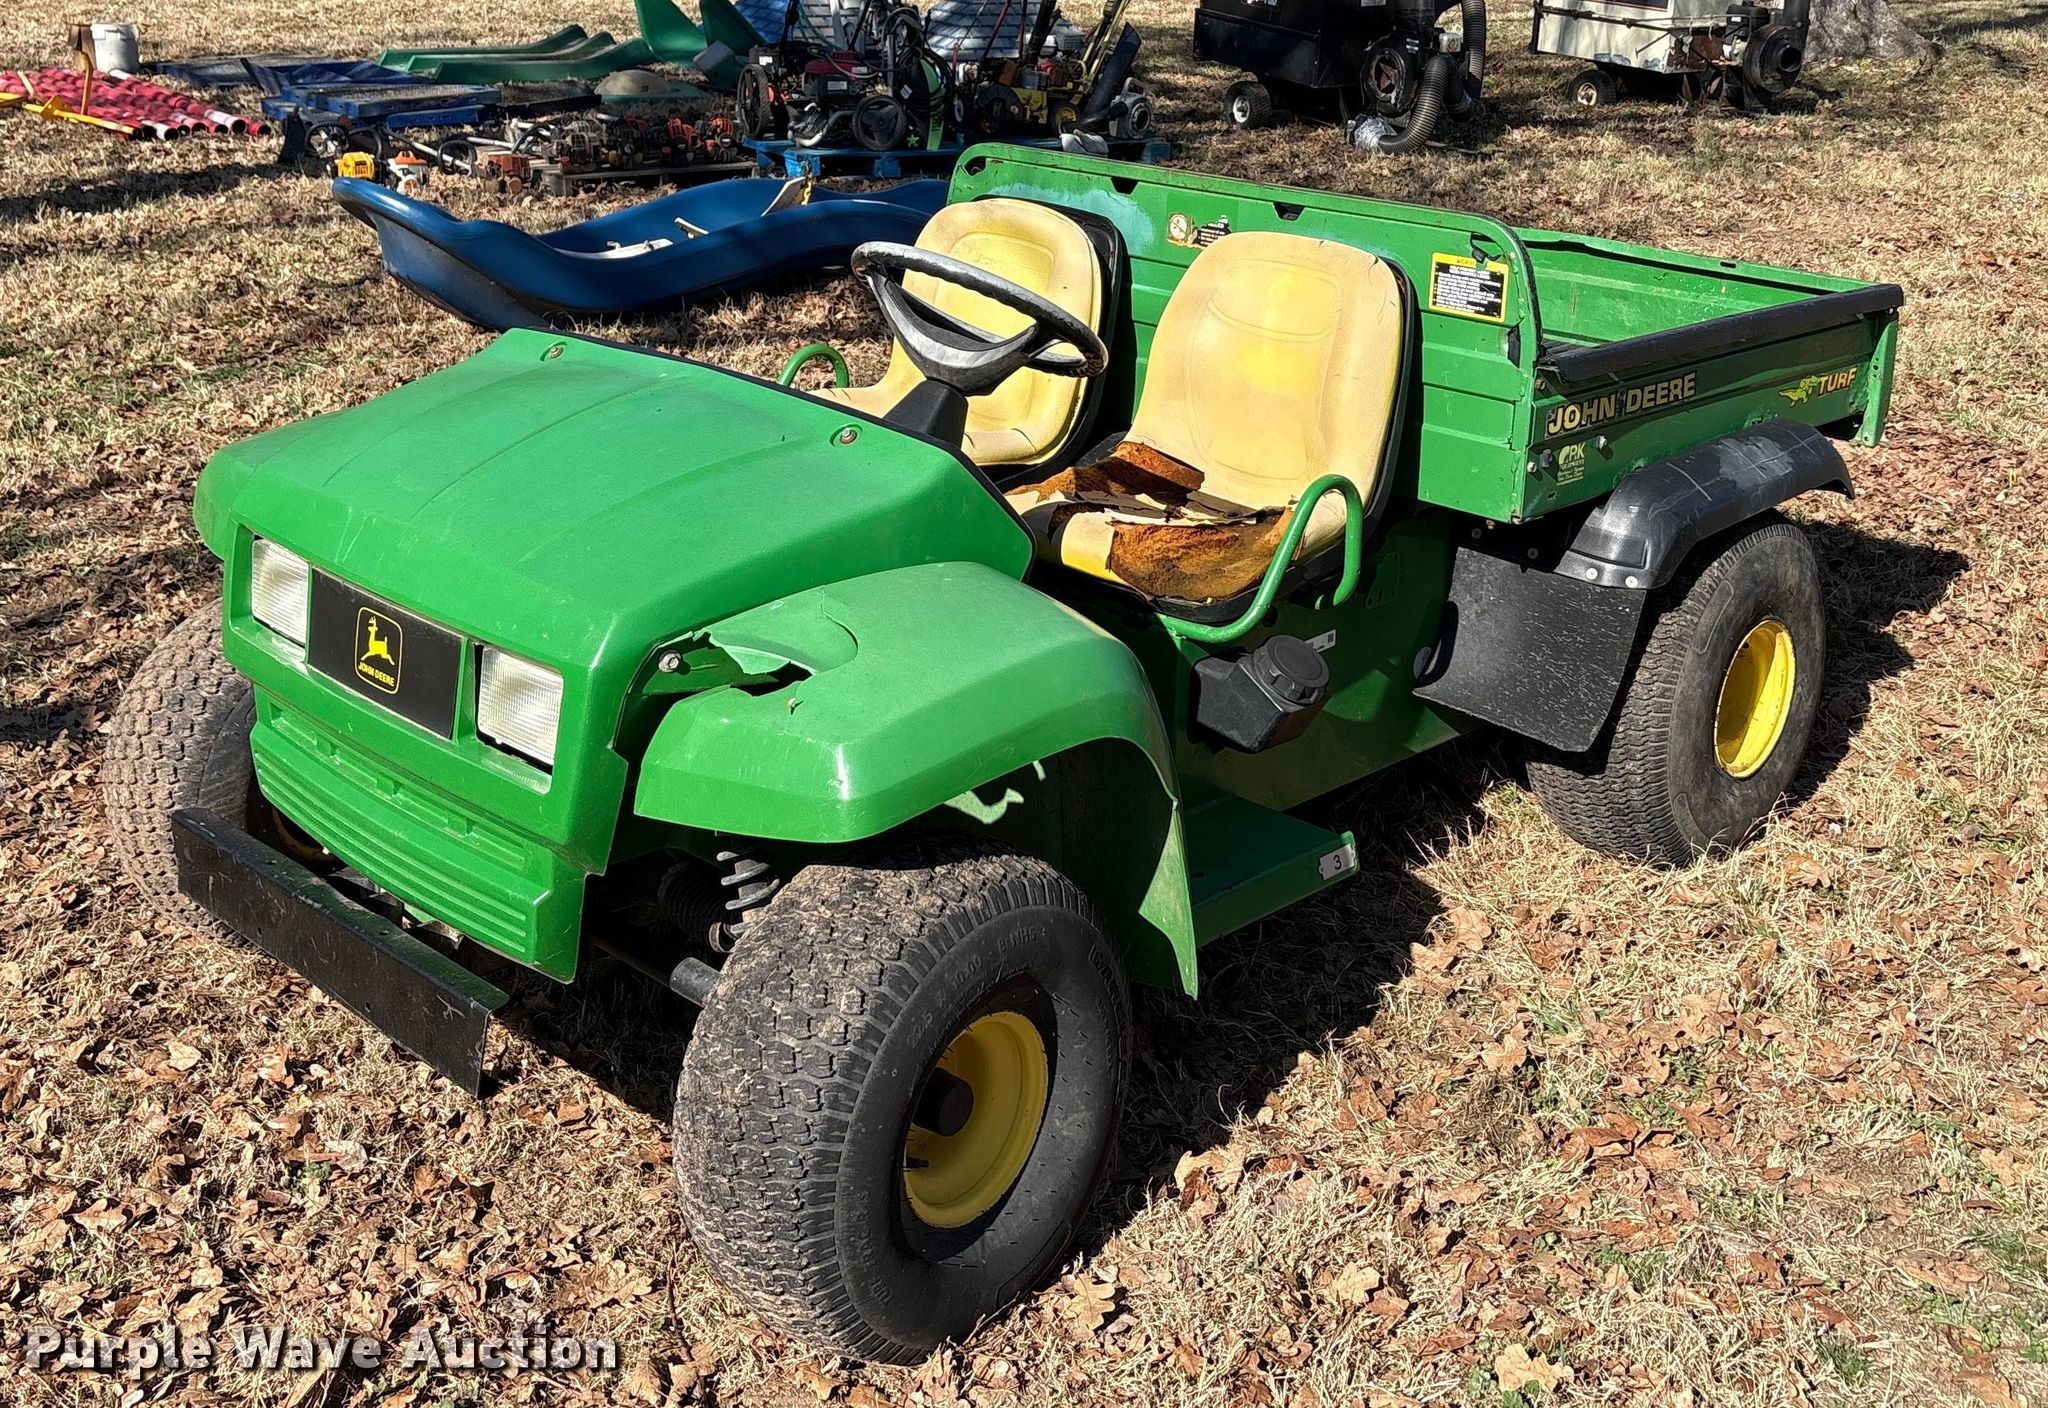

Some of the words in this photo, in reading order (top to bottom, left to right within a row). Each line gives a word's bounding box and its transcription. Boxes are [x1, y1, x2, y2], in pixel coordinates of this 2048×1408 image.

[1818, 367, 1858, 395] TURF
[1548, 393, 1617, 434] JOHN
[1625, 372, 1697, 413] DEERE
[358, 661, 375, 677] JOHN
[374, 669, 395, 687] DEERE
[1333, 854, 1342, 870] 3
